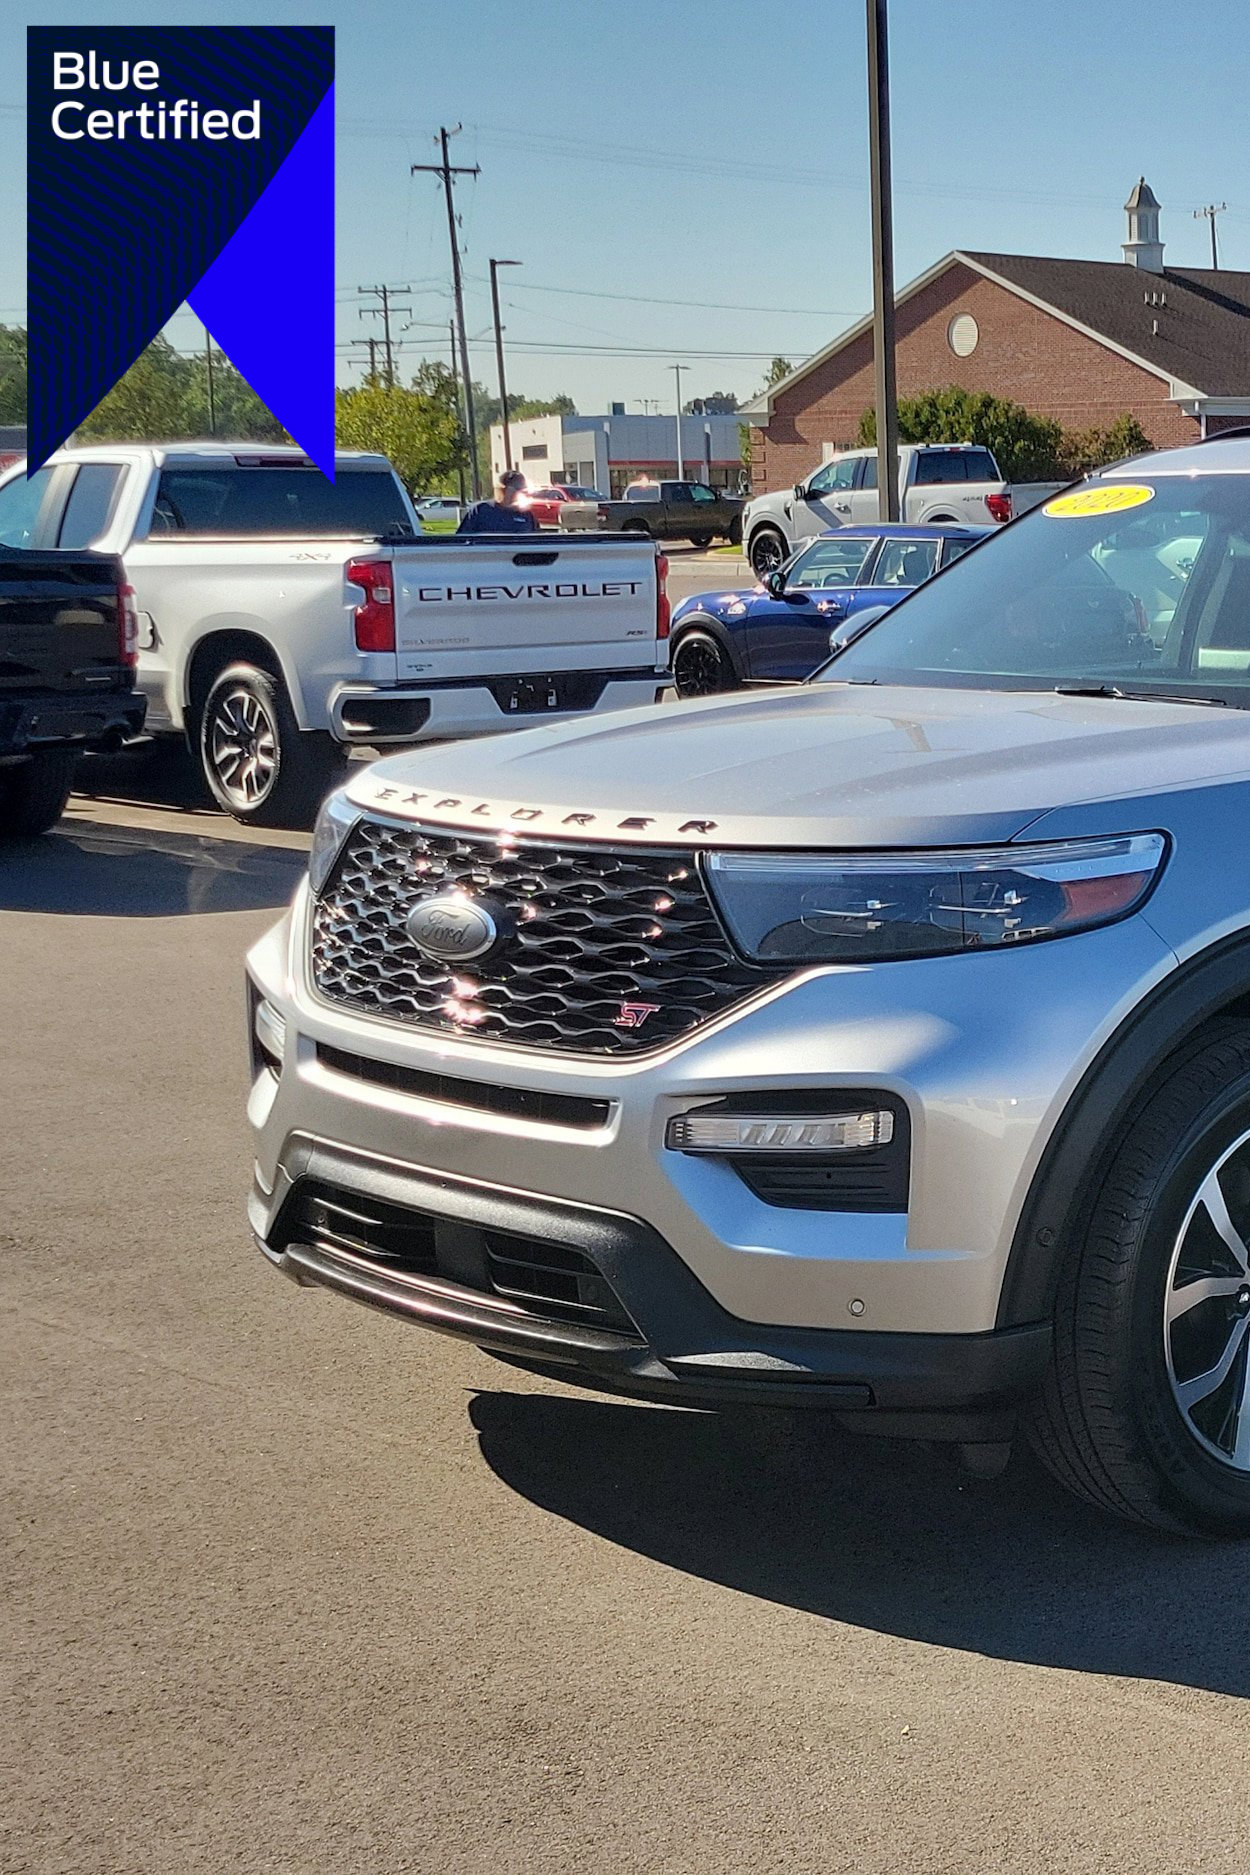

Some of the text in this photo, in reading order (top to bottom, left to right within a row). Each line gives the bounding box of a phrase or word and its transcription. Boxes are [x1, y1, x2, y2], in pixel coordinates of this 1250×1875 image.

[418, 582, 643, 602] CHEVROLET
[374, 787, 719, 834] EXPLORER
[421, 909, 468, 946] Ford
[614, 1002, 661, 1027] ST
